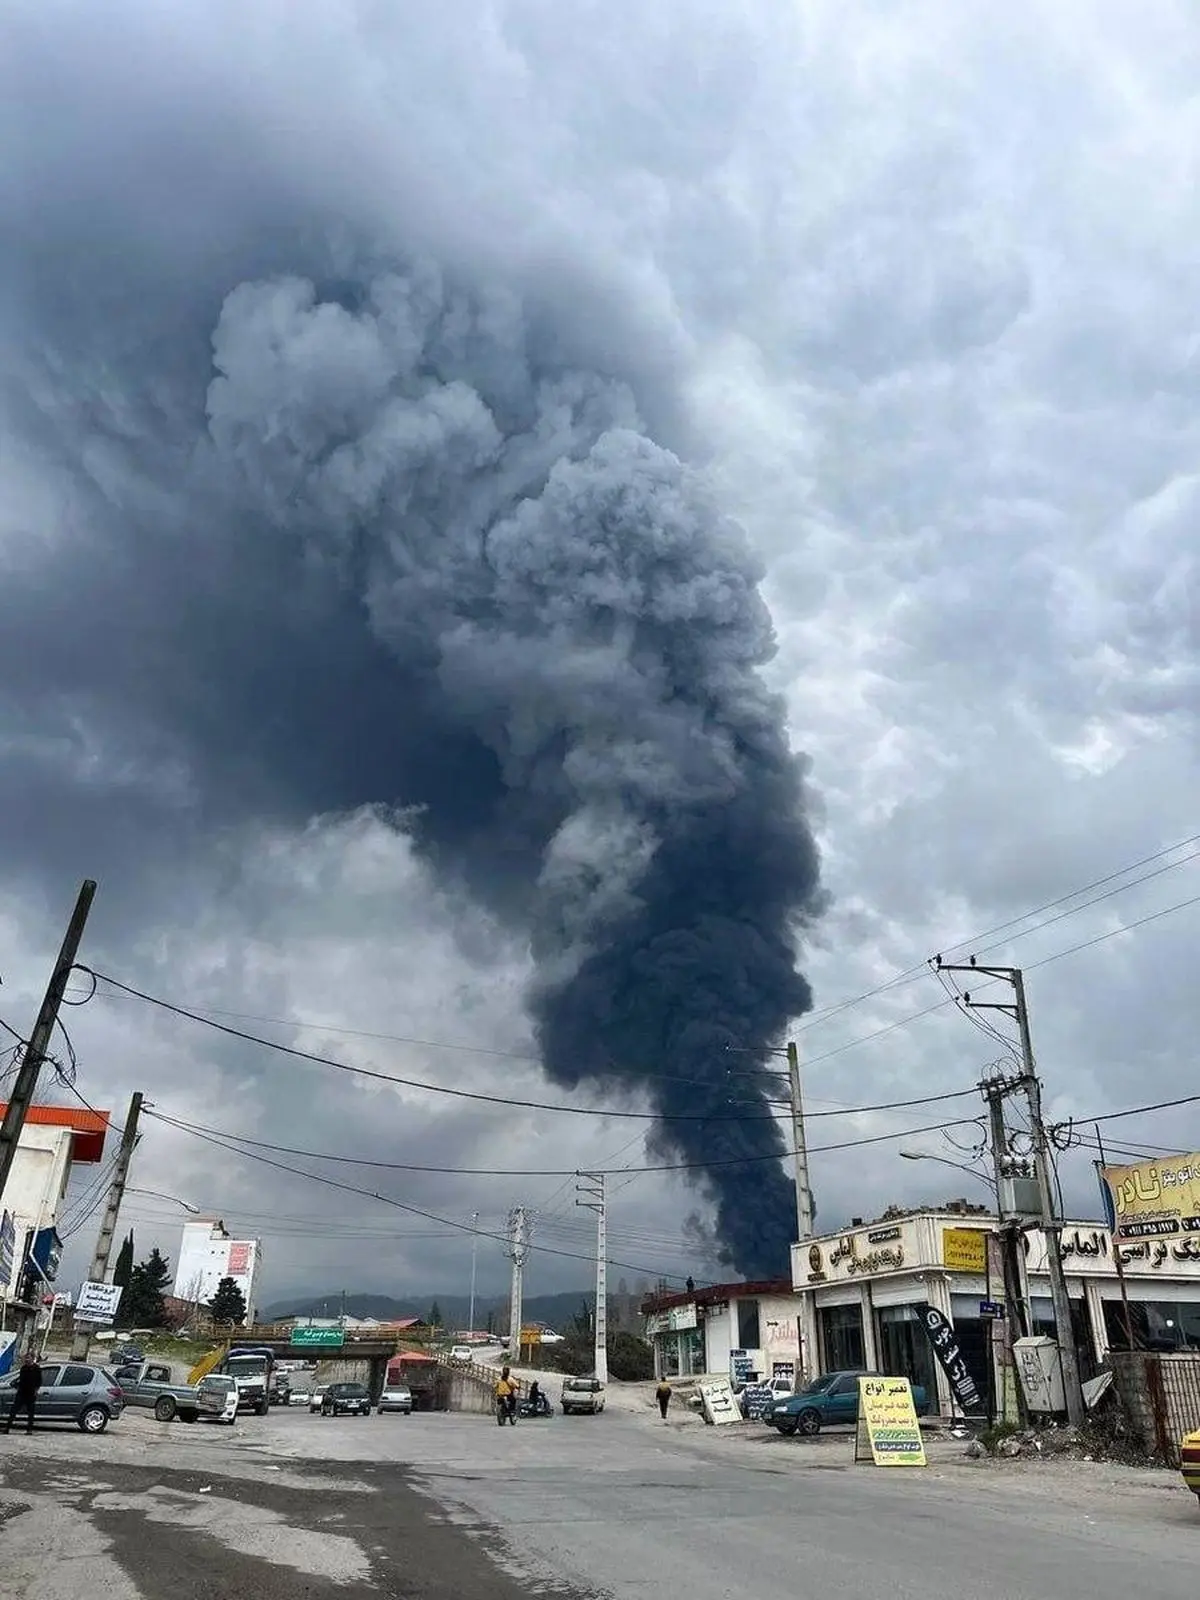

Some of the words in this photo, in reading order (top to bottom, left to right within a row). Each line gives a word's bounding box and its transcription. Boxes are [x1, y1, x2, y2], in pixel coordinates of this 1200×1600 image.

[1116, 1167, 1162, 1214] نادر
[865, 1382, 885, 1396] انواع
[888, 1383, 908, 1396] تعمیر
